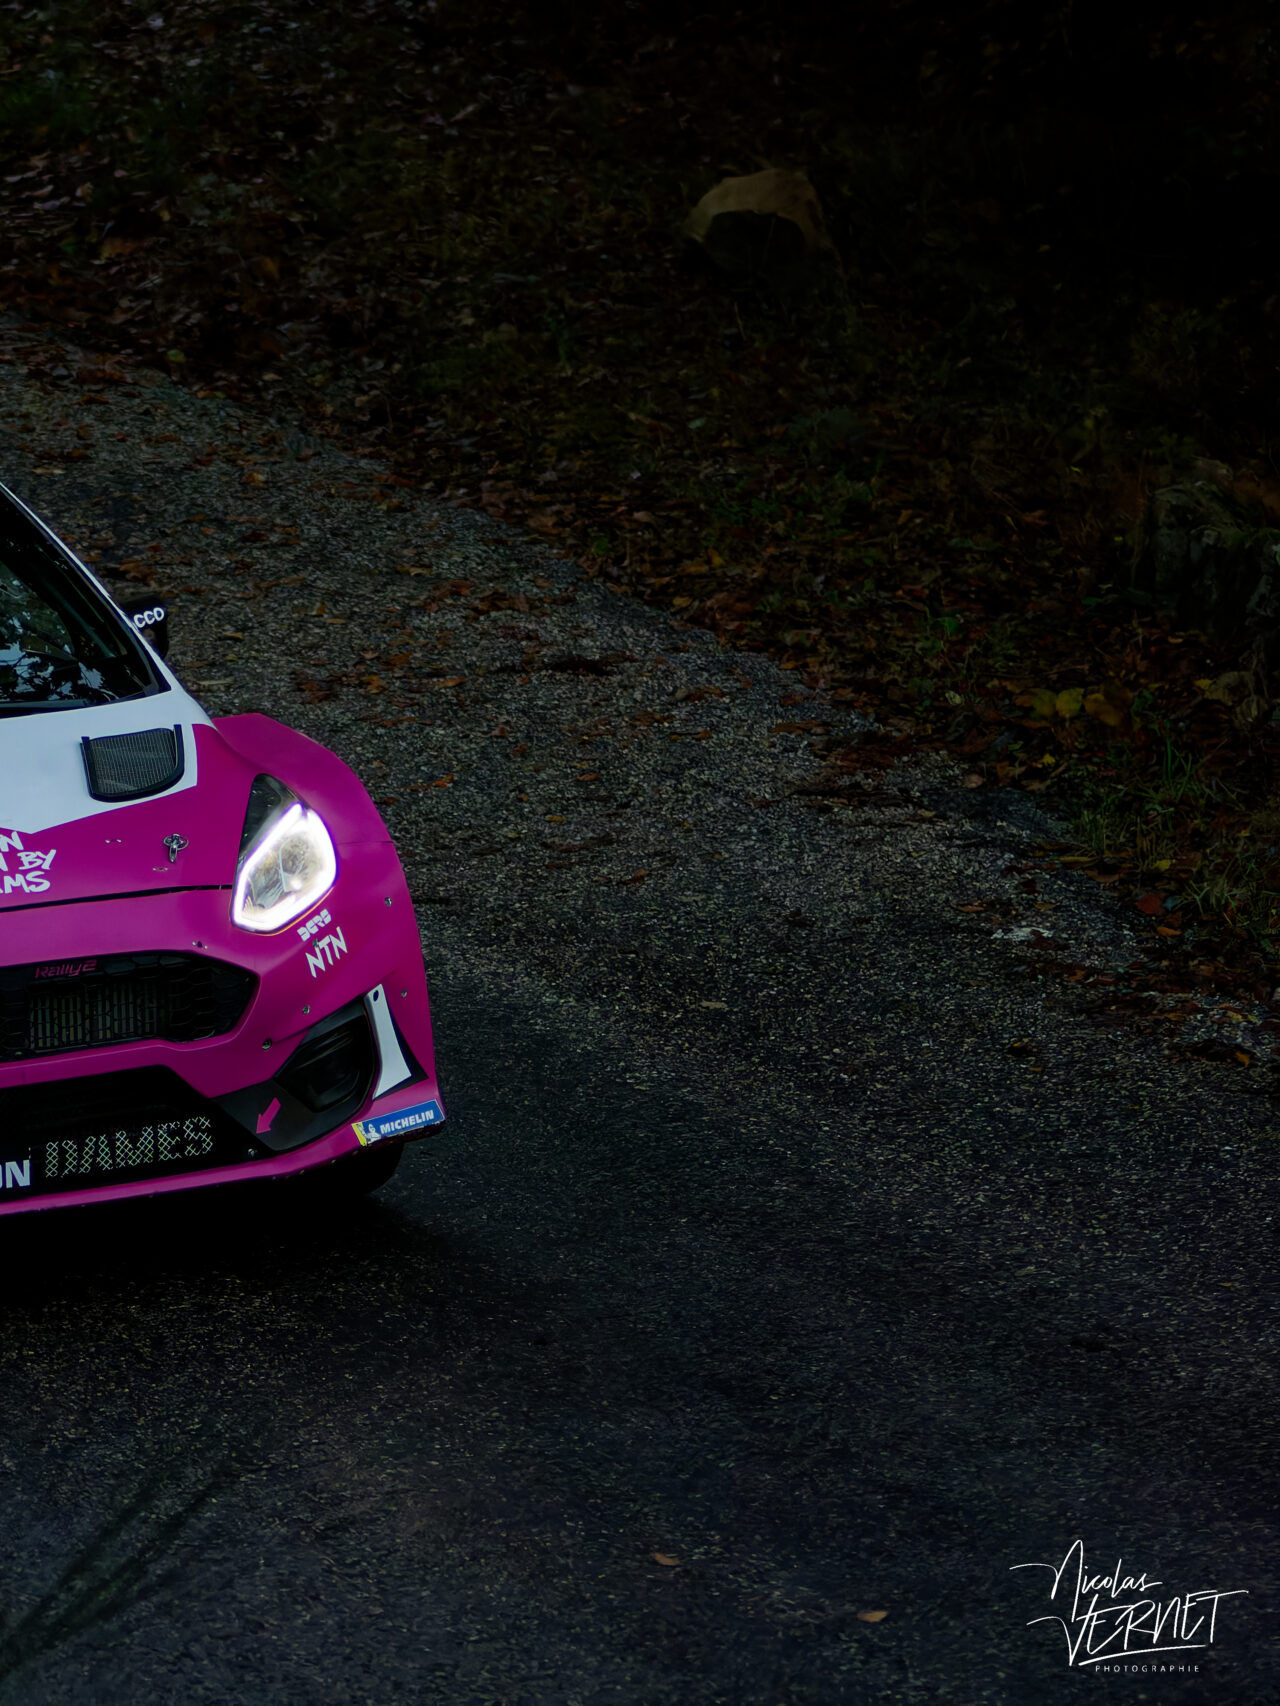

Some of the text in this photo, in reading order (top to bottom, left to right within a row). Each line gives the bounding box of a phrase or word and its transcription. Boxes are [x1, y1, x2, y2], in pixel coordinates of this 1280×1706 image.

[133, 606, 165, 629] CCO
[17, 848, 57, 871] BY
[305, 926, 349, 979] NTN
[380, 1109, 435, 1134] MICHELIN
[45, 1115, 214, 1179] DAMES
